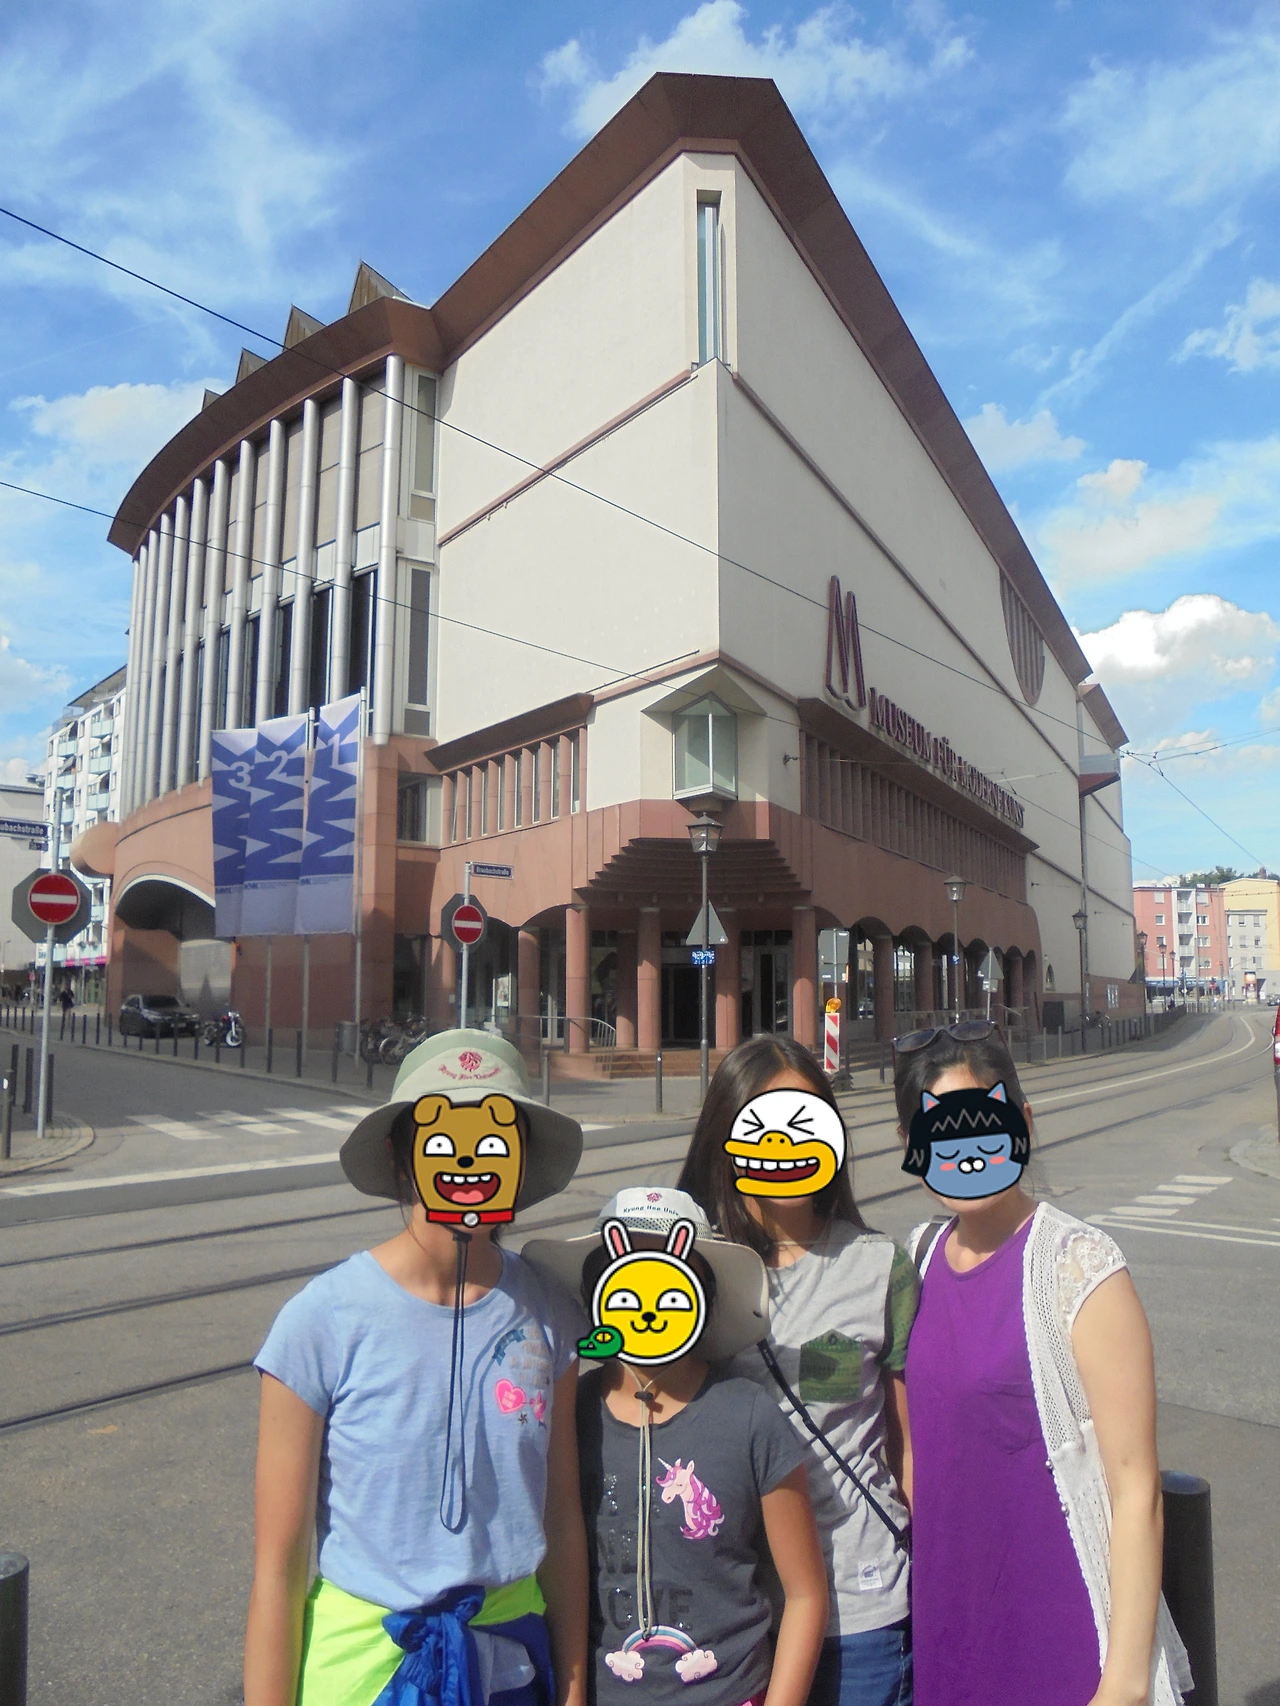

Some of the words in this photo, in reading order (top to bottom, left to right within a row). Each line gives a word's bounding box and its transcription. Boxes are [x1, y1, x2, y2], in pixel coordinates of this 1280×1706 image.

[265, 750, 289, 780] 2
[328, 733, 342, 768] 1
[869, 687, 931, 762] MUSEUM
[933, 735, 957, 782] FÜR
[957, 756, 1002, 812] MODERNE
[1002, 789, 1025, 828] KUNST
[228, 761, 252, 787] 3
